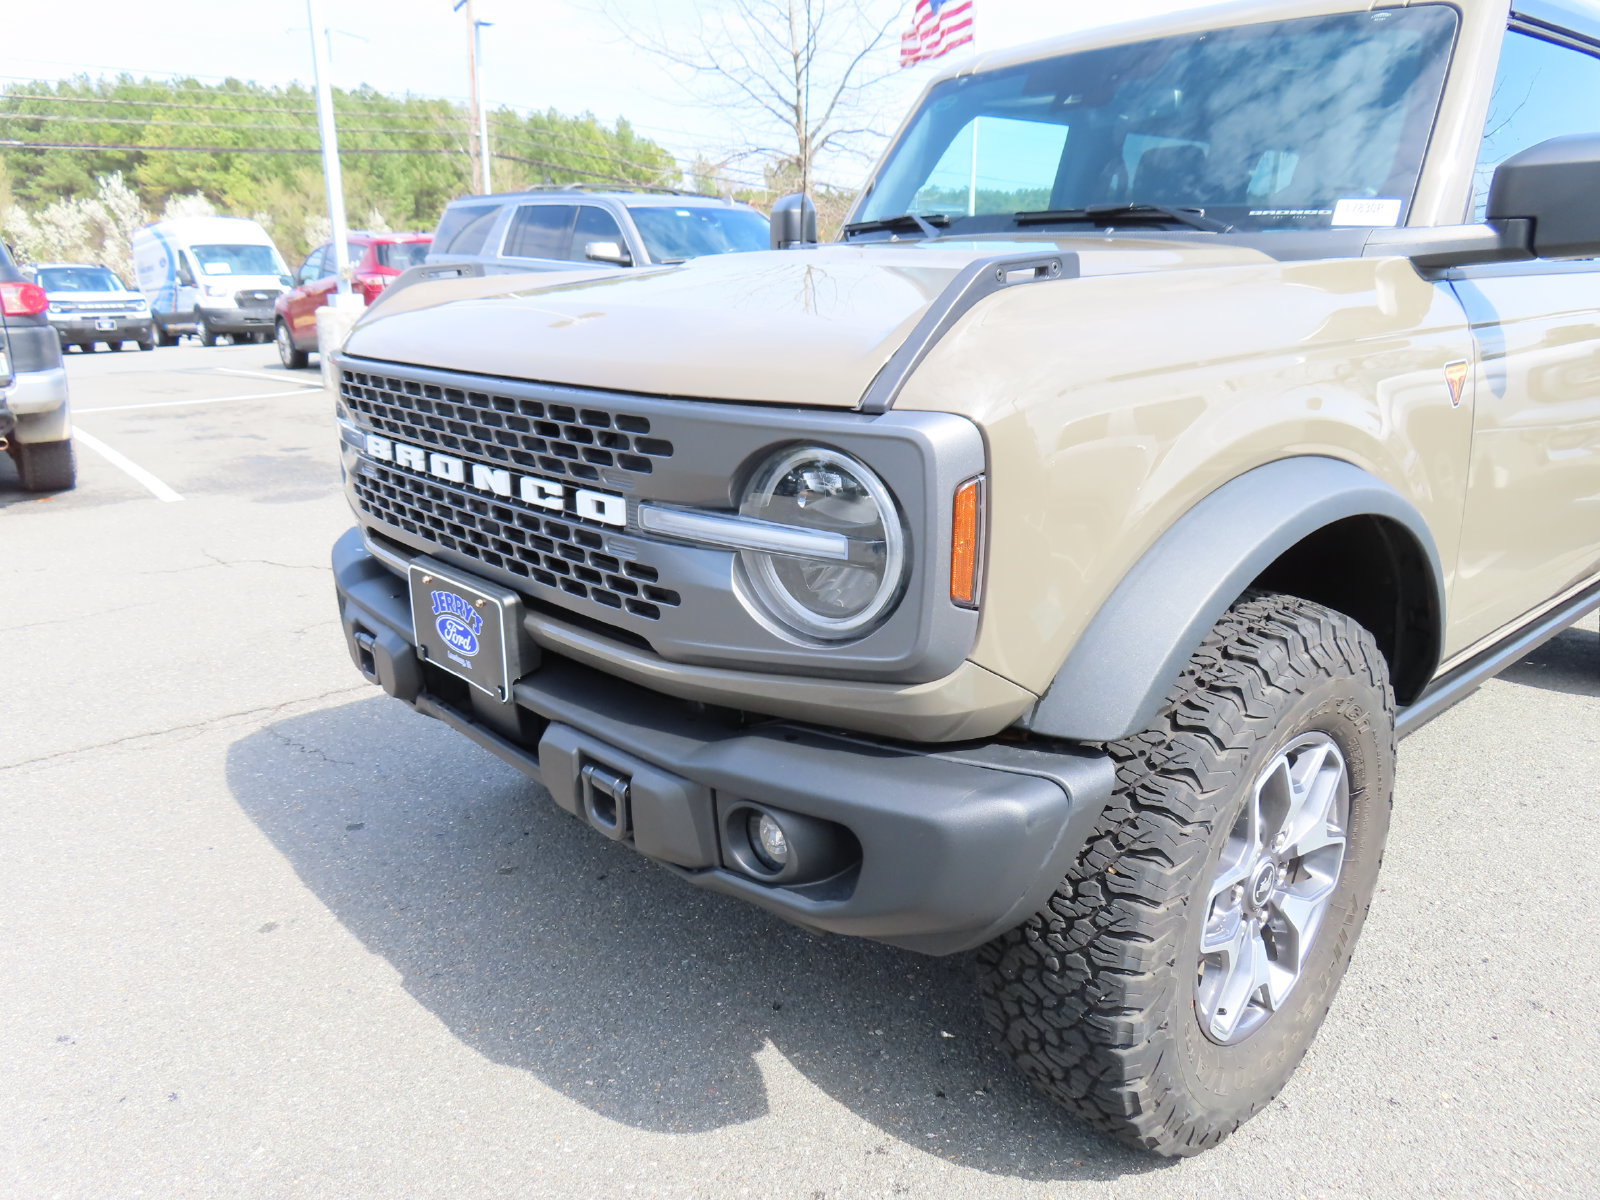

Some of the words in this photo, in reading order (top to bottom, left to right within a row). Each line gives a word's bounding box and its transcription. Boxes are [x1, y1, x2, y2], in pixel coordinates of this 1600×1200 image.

[366, 434, 627, 526] BRONCO
[431, 590, 484, 635] JERRY'S
[444, 620, 472, 650] Ford
